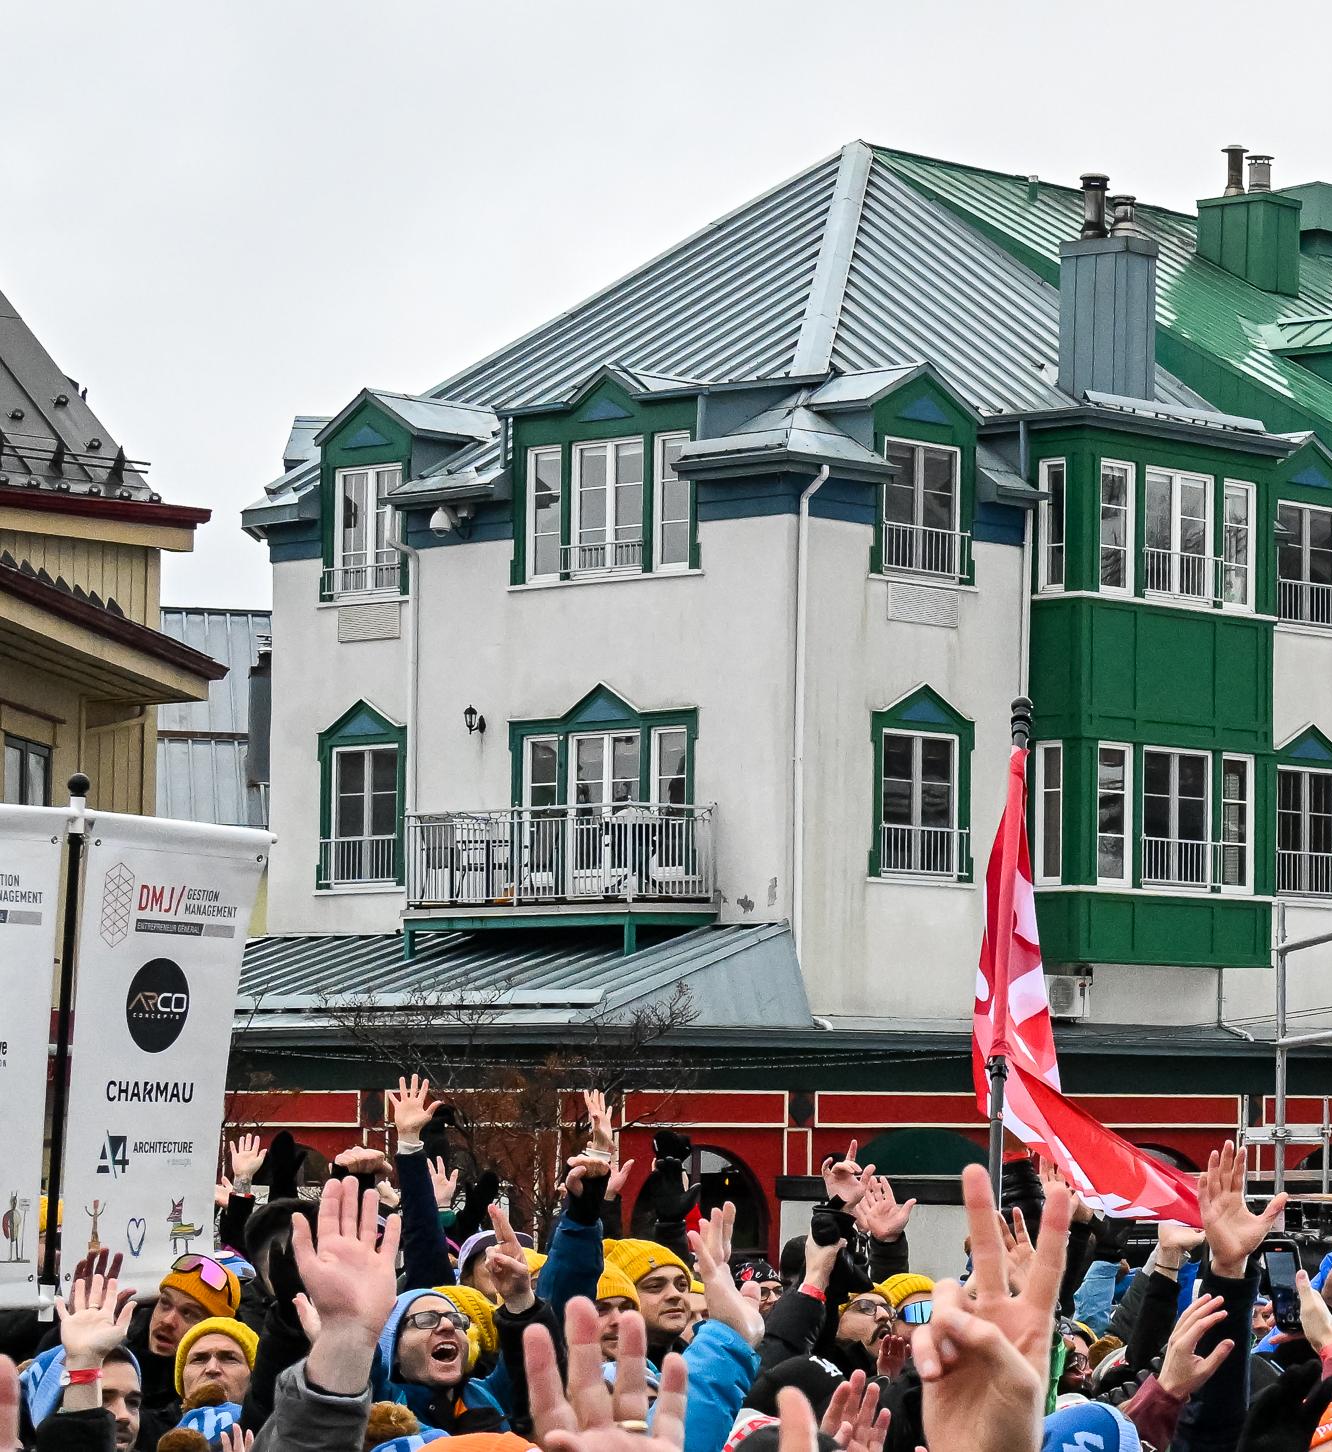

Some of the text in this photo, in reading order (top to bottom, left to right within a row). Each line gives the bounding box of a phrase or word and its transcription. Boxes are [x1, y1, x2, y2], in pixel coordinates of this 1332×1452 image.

[187, 888, 219, 902] GESTION
[184, 903, 237, 918] MANAGEMENT
[128, 992, 187, 1012] ARCO
[132, 1012, 180, 1020] CONCEPTS
[106, 1080, 194, 1103] CHARMAU
[133, 1141, 193, 1153] ARCHITECTURE
